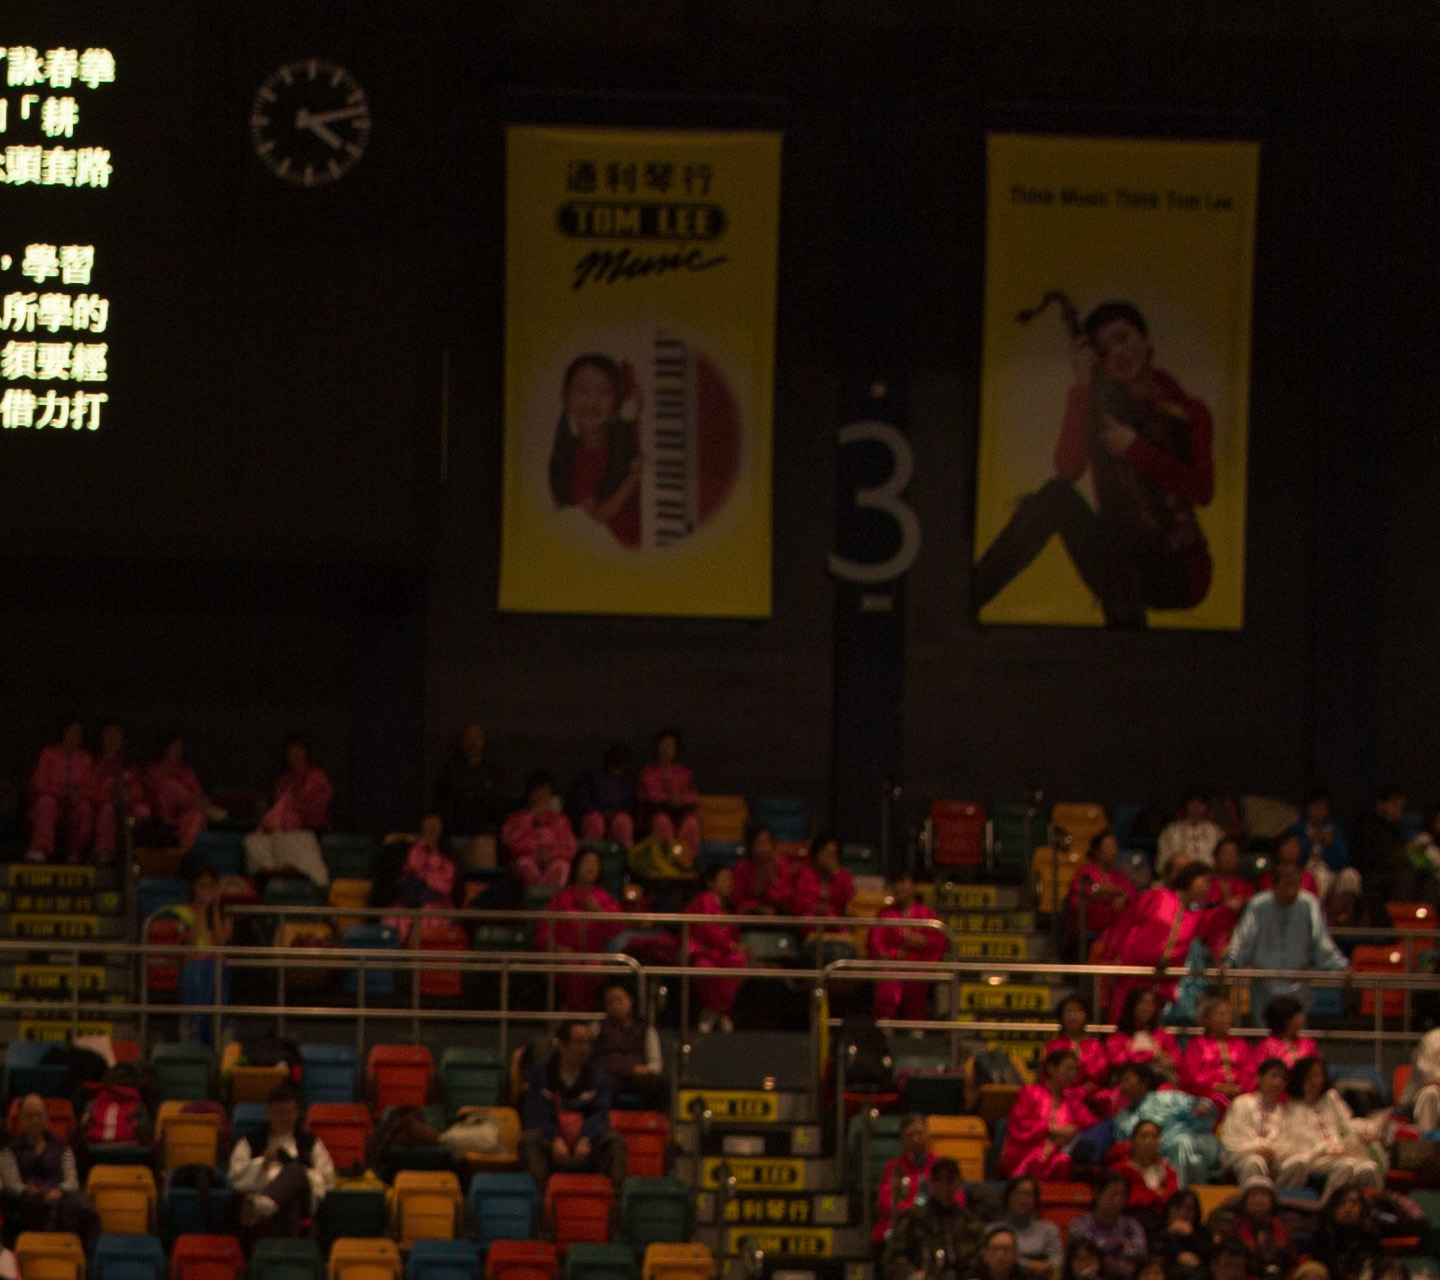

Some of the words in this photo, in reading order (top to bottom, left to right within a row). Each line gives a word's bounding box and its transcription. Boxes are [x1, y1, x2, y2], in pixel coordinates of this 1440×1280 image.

[566, 160, 714, 195] 通利琴行
[575, 206, 641, 236] TOM
[658, 207, 712, 237] LEE
[572, 241, 725, 289] Music
[828, 420, 922, 584] 3
